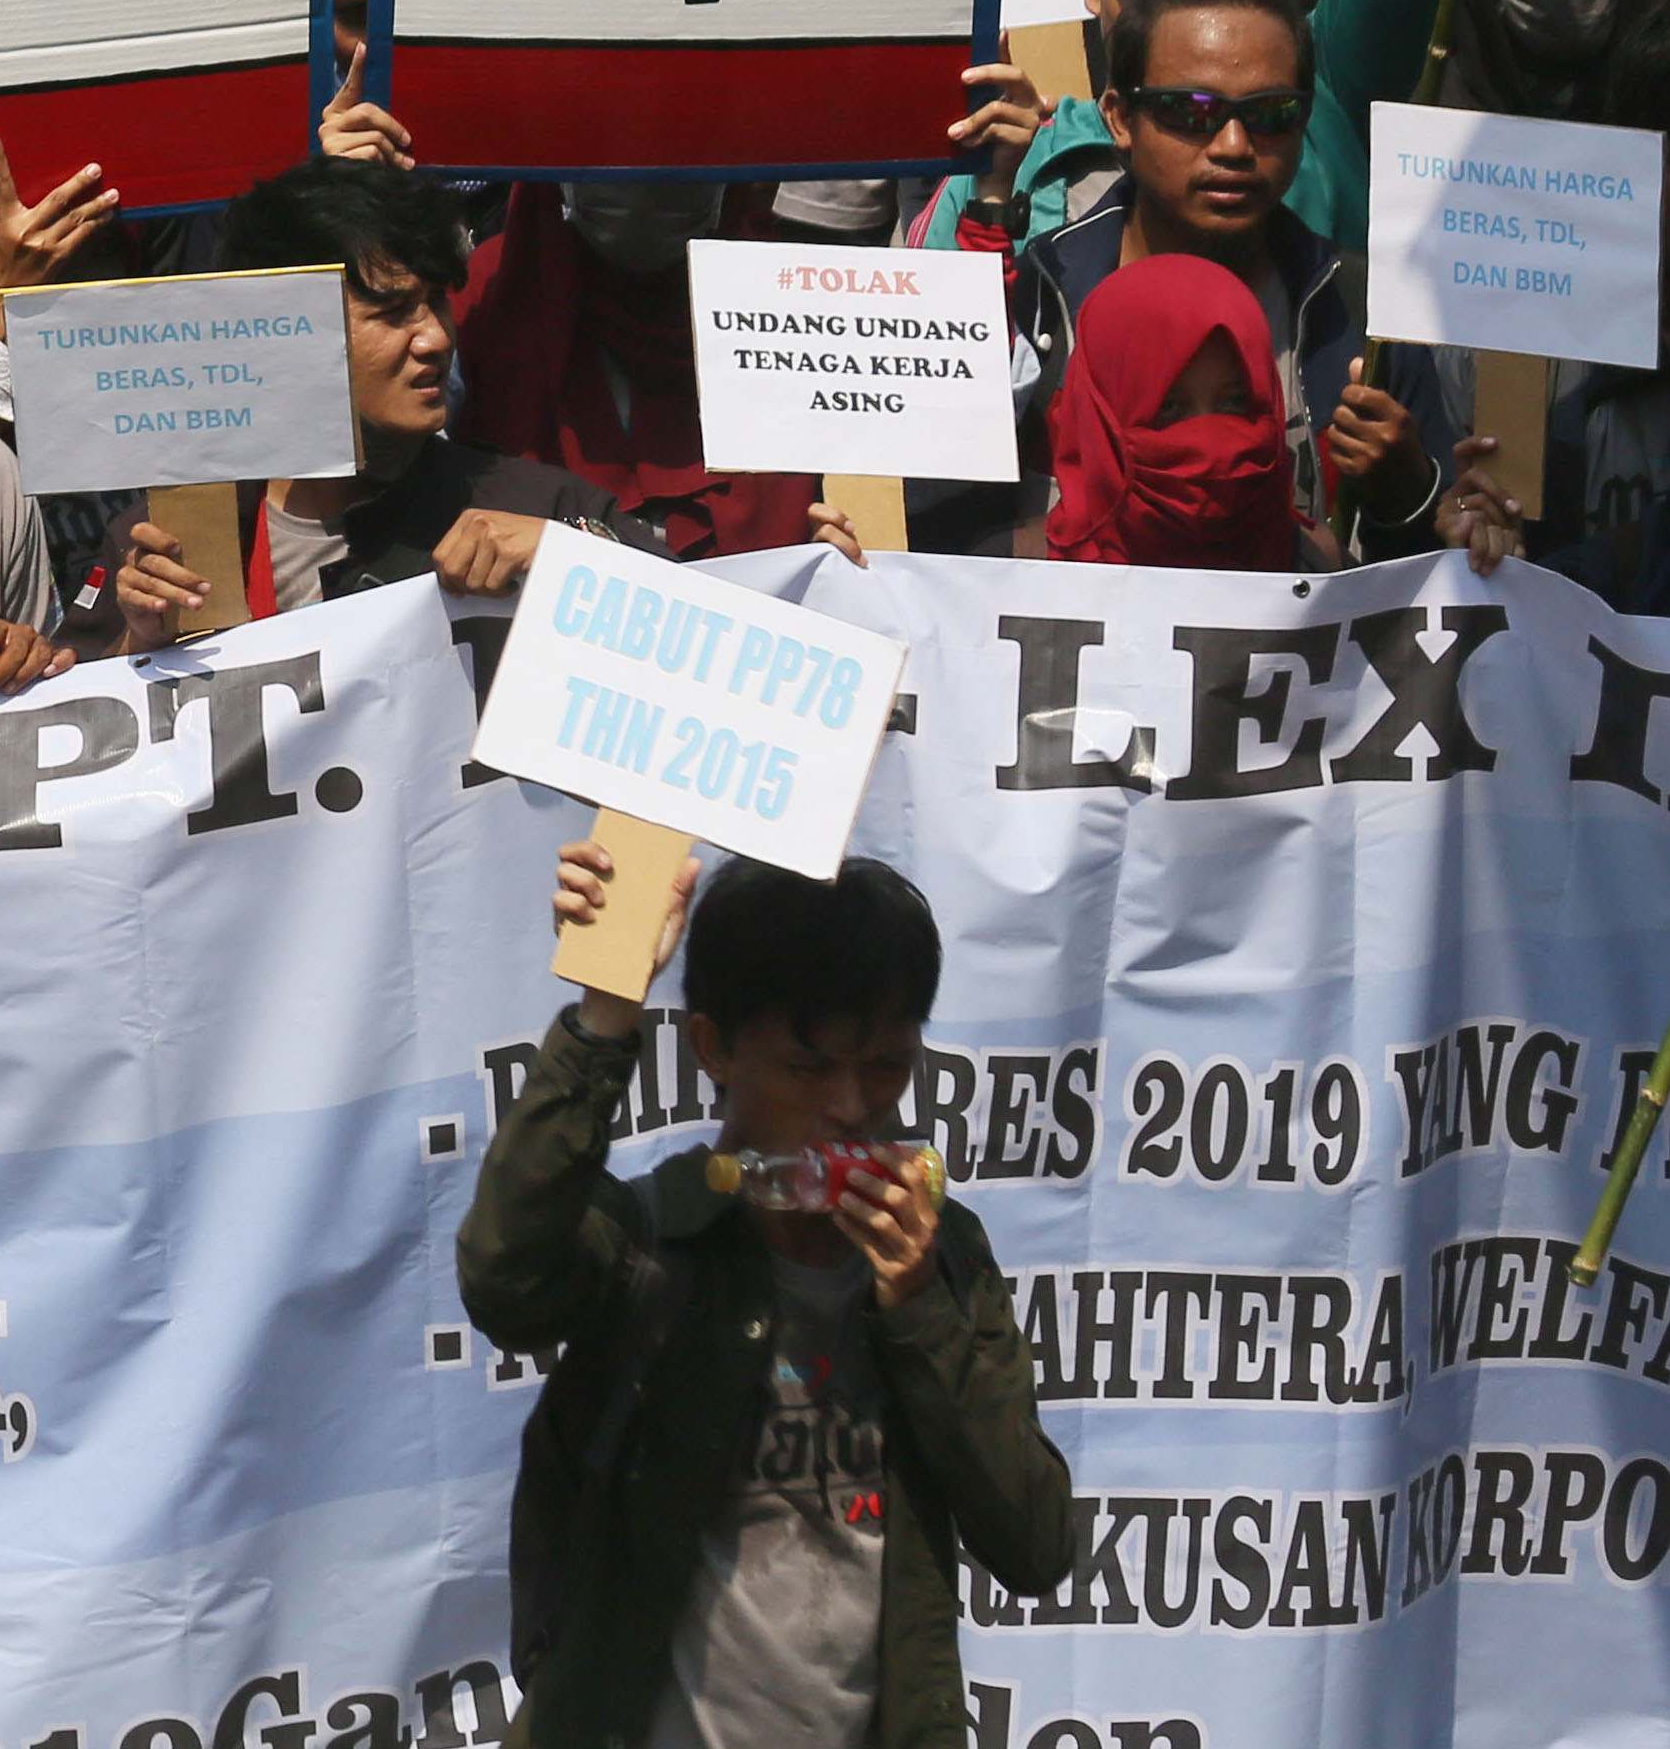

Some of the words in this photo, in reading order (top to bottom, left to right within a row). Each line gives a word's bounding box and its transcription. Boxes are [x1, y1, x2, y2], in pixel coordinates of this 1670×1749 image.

[1397, 152, 1539, 195] TURUNKAN
[1544, 169, 1636, 202] HARGA
[1442, 206, 1530, 245] BERAS,
[1534, 216, 1589, 252] TDL,
[777, 264, 921, 298] #TOLAK
[1452, 258, 1510, 292] DAN
[1515, 265, 1573, 298] BBM
[37, 318, 203, 353] TURUNKAN
[209, 313, 315, 342] HARGA
[712, 307, 848, 338] UNDANG
[855, 312, 992, 344] UNDANG
[95, 363, 196, 397] BERAS,
[201, 361, 266, 390] TDL,
[733, 348, 861, 378] TENAGA
[868, 352, 975, 383] KERJA
[114, 408, 179, 437] DAN
[185, 404, 253, 432] BBM
[809, 388, 906, 417] ASING
[552, 562, 732, 684] CABUT
[727, 622, 864, 731] PP78
[995, 605, 1510, 802] LEX
[555, 674, 671, 775] THN
[659, 716, 801, 822] 2015
[1125, 1058, 1362, 1187] 2019
[1392, 1022, 1581, 1179] YANG
[1013, 1270, 1416, 1417] AHTERA,
